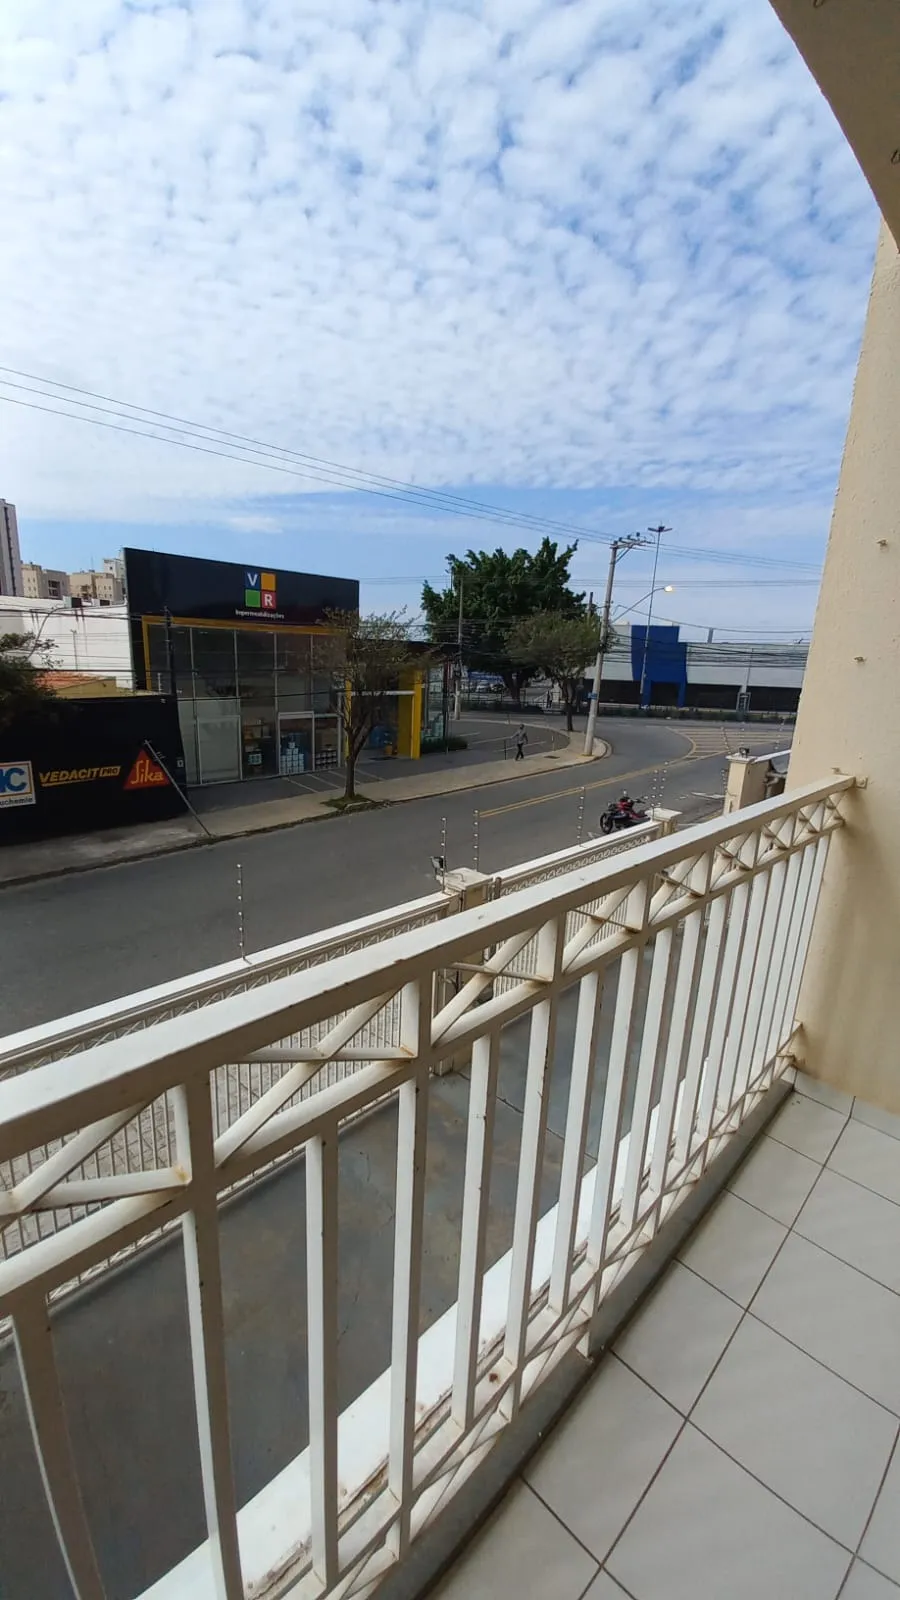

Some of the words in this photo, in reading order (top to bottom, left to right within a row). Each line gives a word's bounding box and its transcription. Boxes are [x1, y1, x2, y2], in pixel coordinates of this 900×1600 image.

[247, 573, 258, 586] V
[264, 593, 273, 606] R
[39, 767, 100, 783] VEDACIT
[131, 760, 164, 784] Sika
